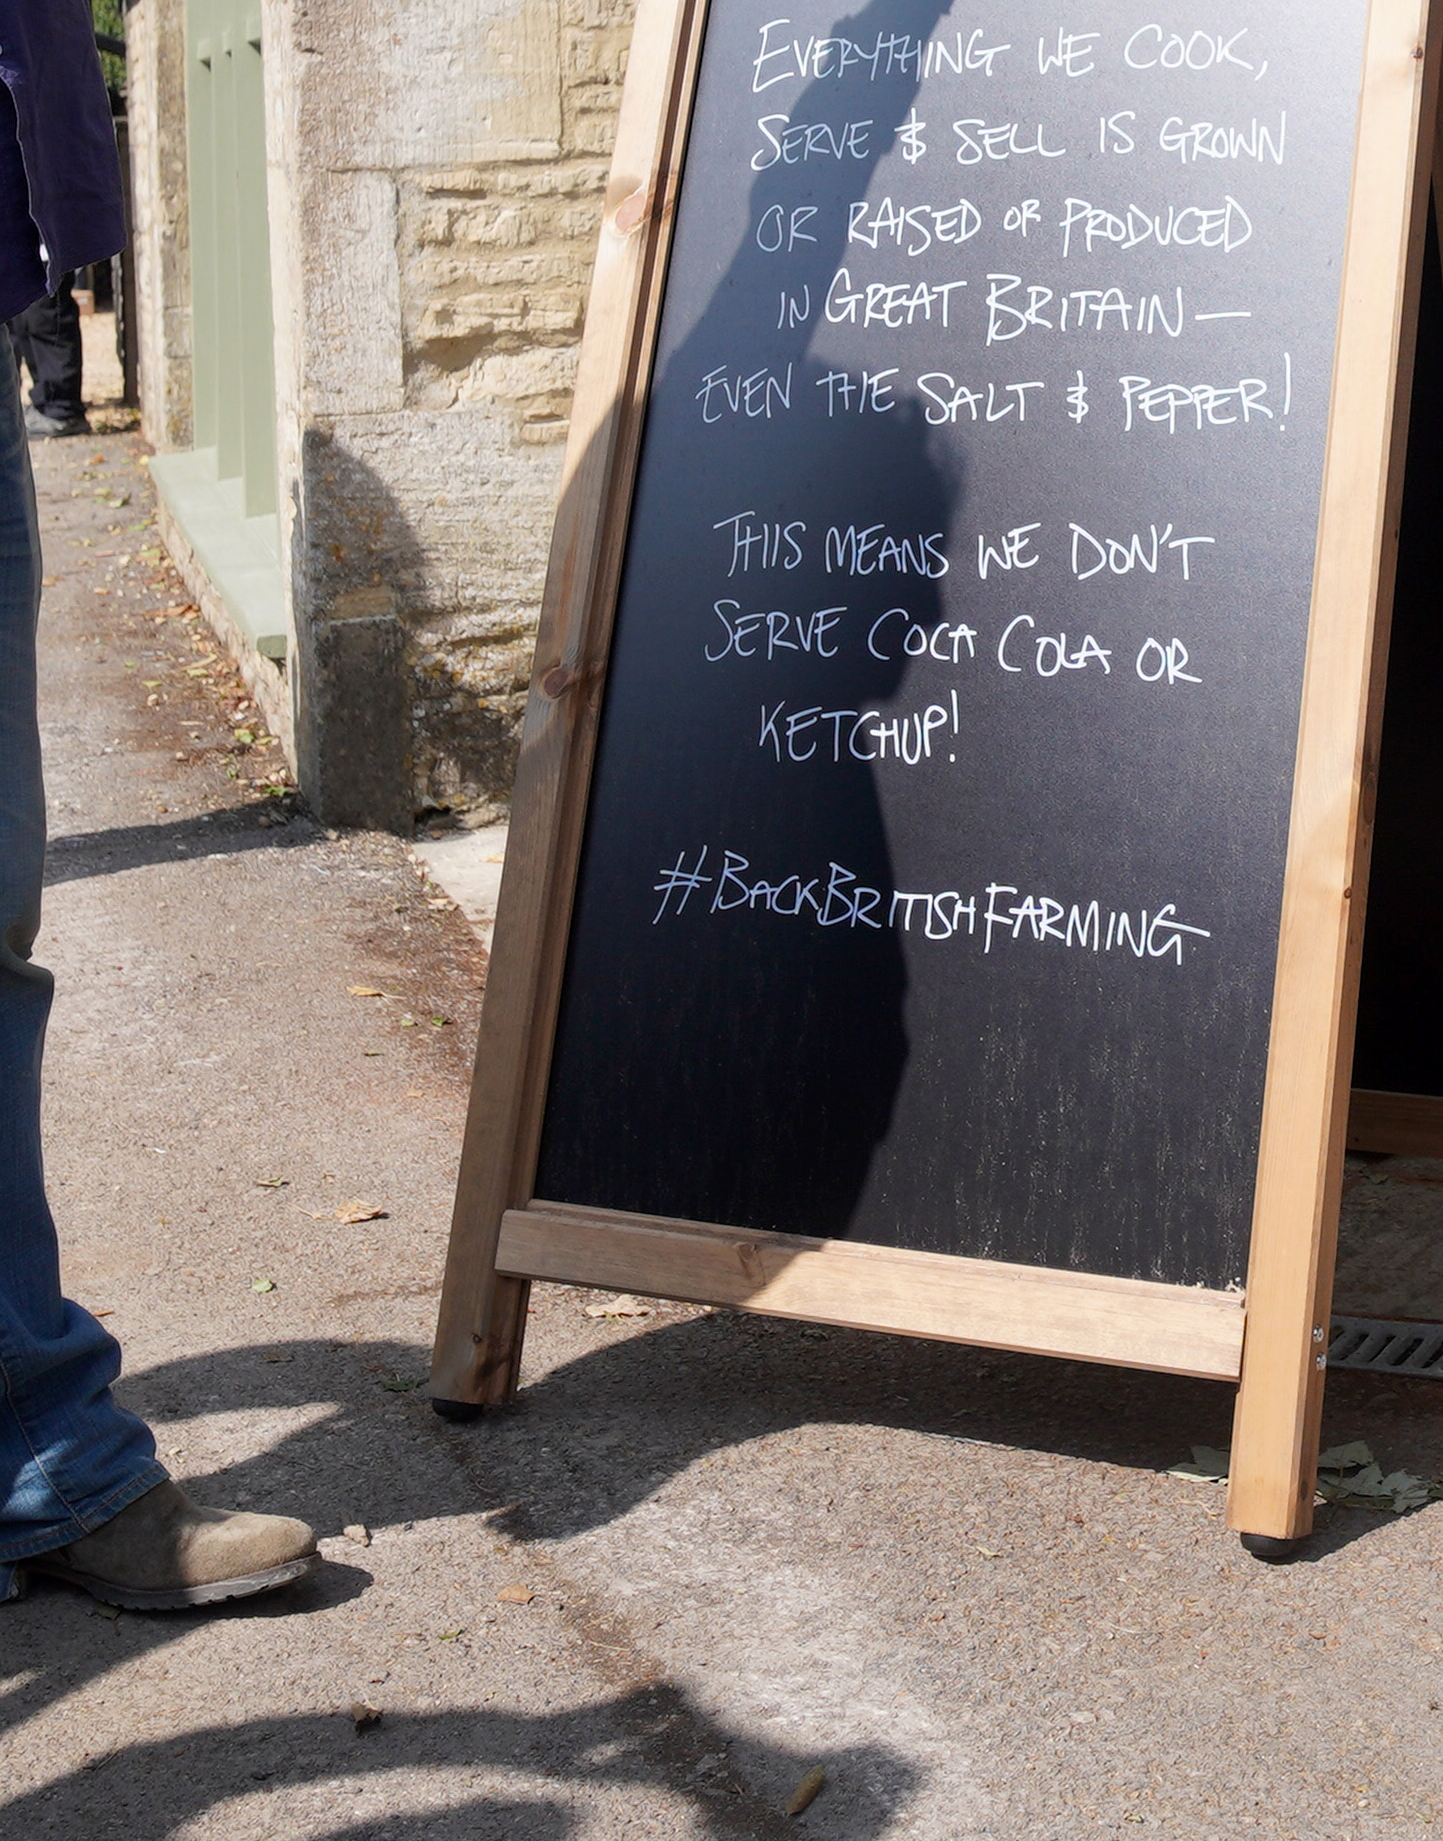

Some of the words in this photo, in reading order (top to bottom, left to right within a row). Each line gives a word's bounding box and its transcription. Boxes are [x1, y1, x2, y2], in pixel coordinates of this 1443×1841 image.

[752, 18, 1011, 93] EVERYTHING
[1038, 27, 1101, 77] WE
[1124, 24, 1270, 81] COOK,
[750, 113, 874, 171] SERVE
[952, 118, 1067, 165] SELL
[1100, 110, 1136, 154] IS
[1159, 110, 1287, 165] GROWN
[756, 204, 819, 253] OR
[847, 196, 982, 257] RAISED
[1003, 198, 1042, 238] OR
[1059, 195, 1252, 258] PRODUCED
[777, 286, 810, 330] IN
[824, 267, 968, 329] GREAT
[696, 364, 793, 424] EVEN
[815, 367, 900, 418] THE
[916, 372, 1045, 426] SALT
[1118, 352, 1291, 435] PEPPER!
[712, 510, 807, 578] THIS
[825, 523, 950, 579] MEANS
[977, 522, 1042, 580] WE
[1068, 522, 1216, 581] DON'T
[704, 598, 848, 662] SERVE
[867, 607, 978, 664] COCA
[997, 614, 1113, 678] COLA
[1135, 637, 1203, 685] OR
[758, 688, 959, 766] KETCHUP!
